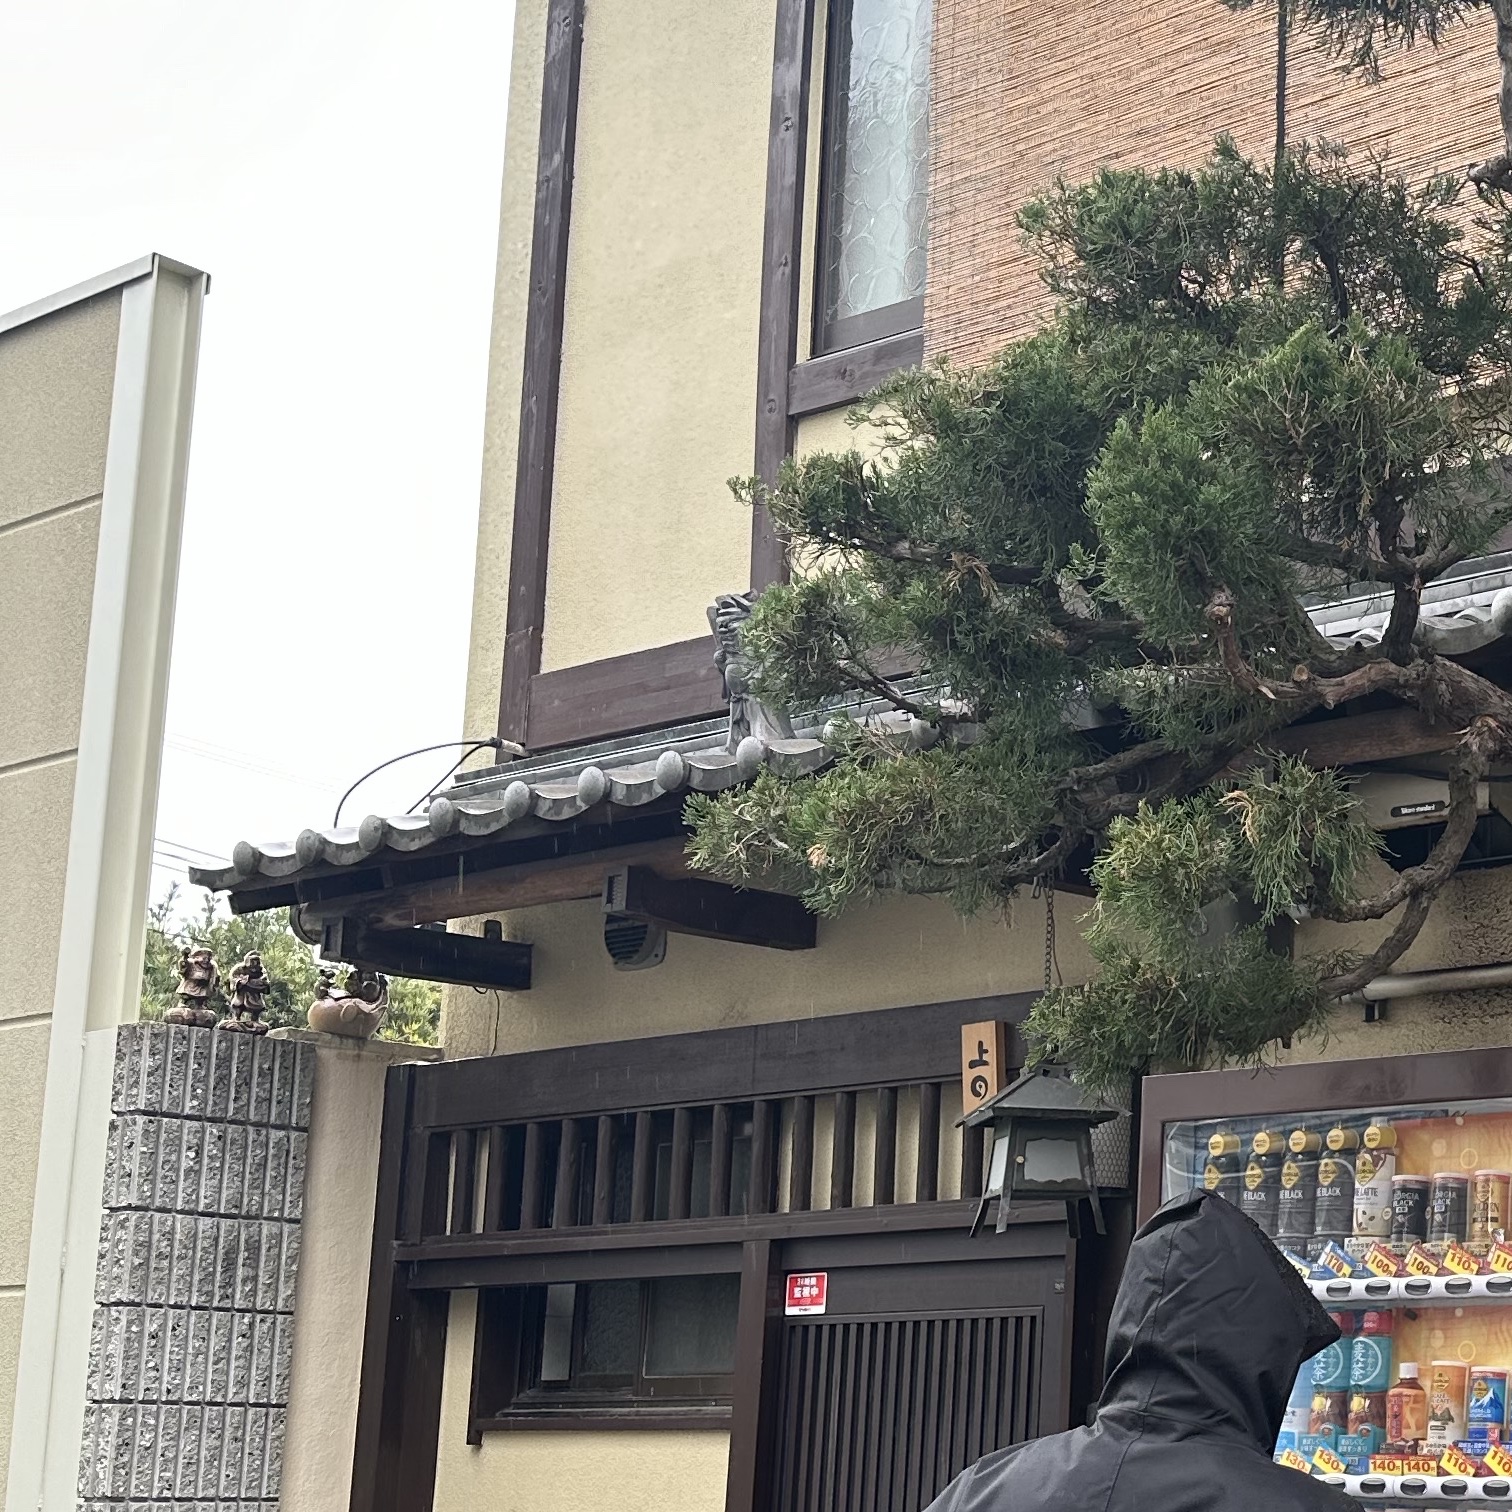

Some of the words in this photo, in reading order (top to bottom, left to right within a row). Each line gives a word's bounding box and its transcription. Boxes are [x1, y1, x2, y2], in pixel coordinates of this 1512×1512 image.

[1247, 1191, 1266, 1201] BLACK
[1285, 1190, 1303, 1199] BLACK
[1321, 1187, 1341, 1197] BLACK
[1351, 1343, 1365, 1380] 麦茶
[1371, 1460, 1400, 1471] 140円
[1405, 1461, 1435, 1472] 140円
